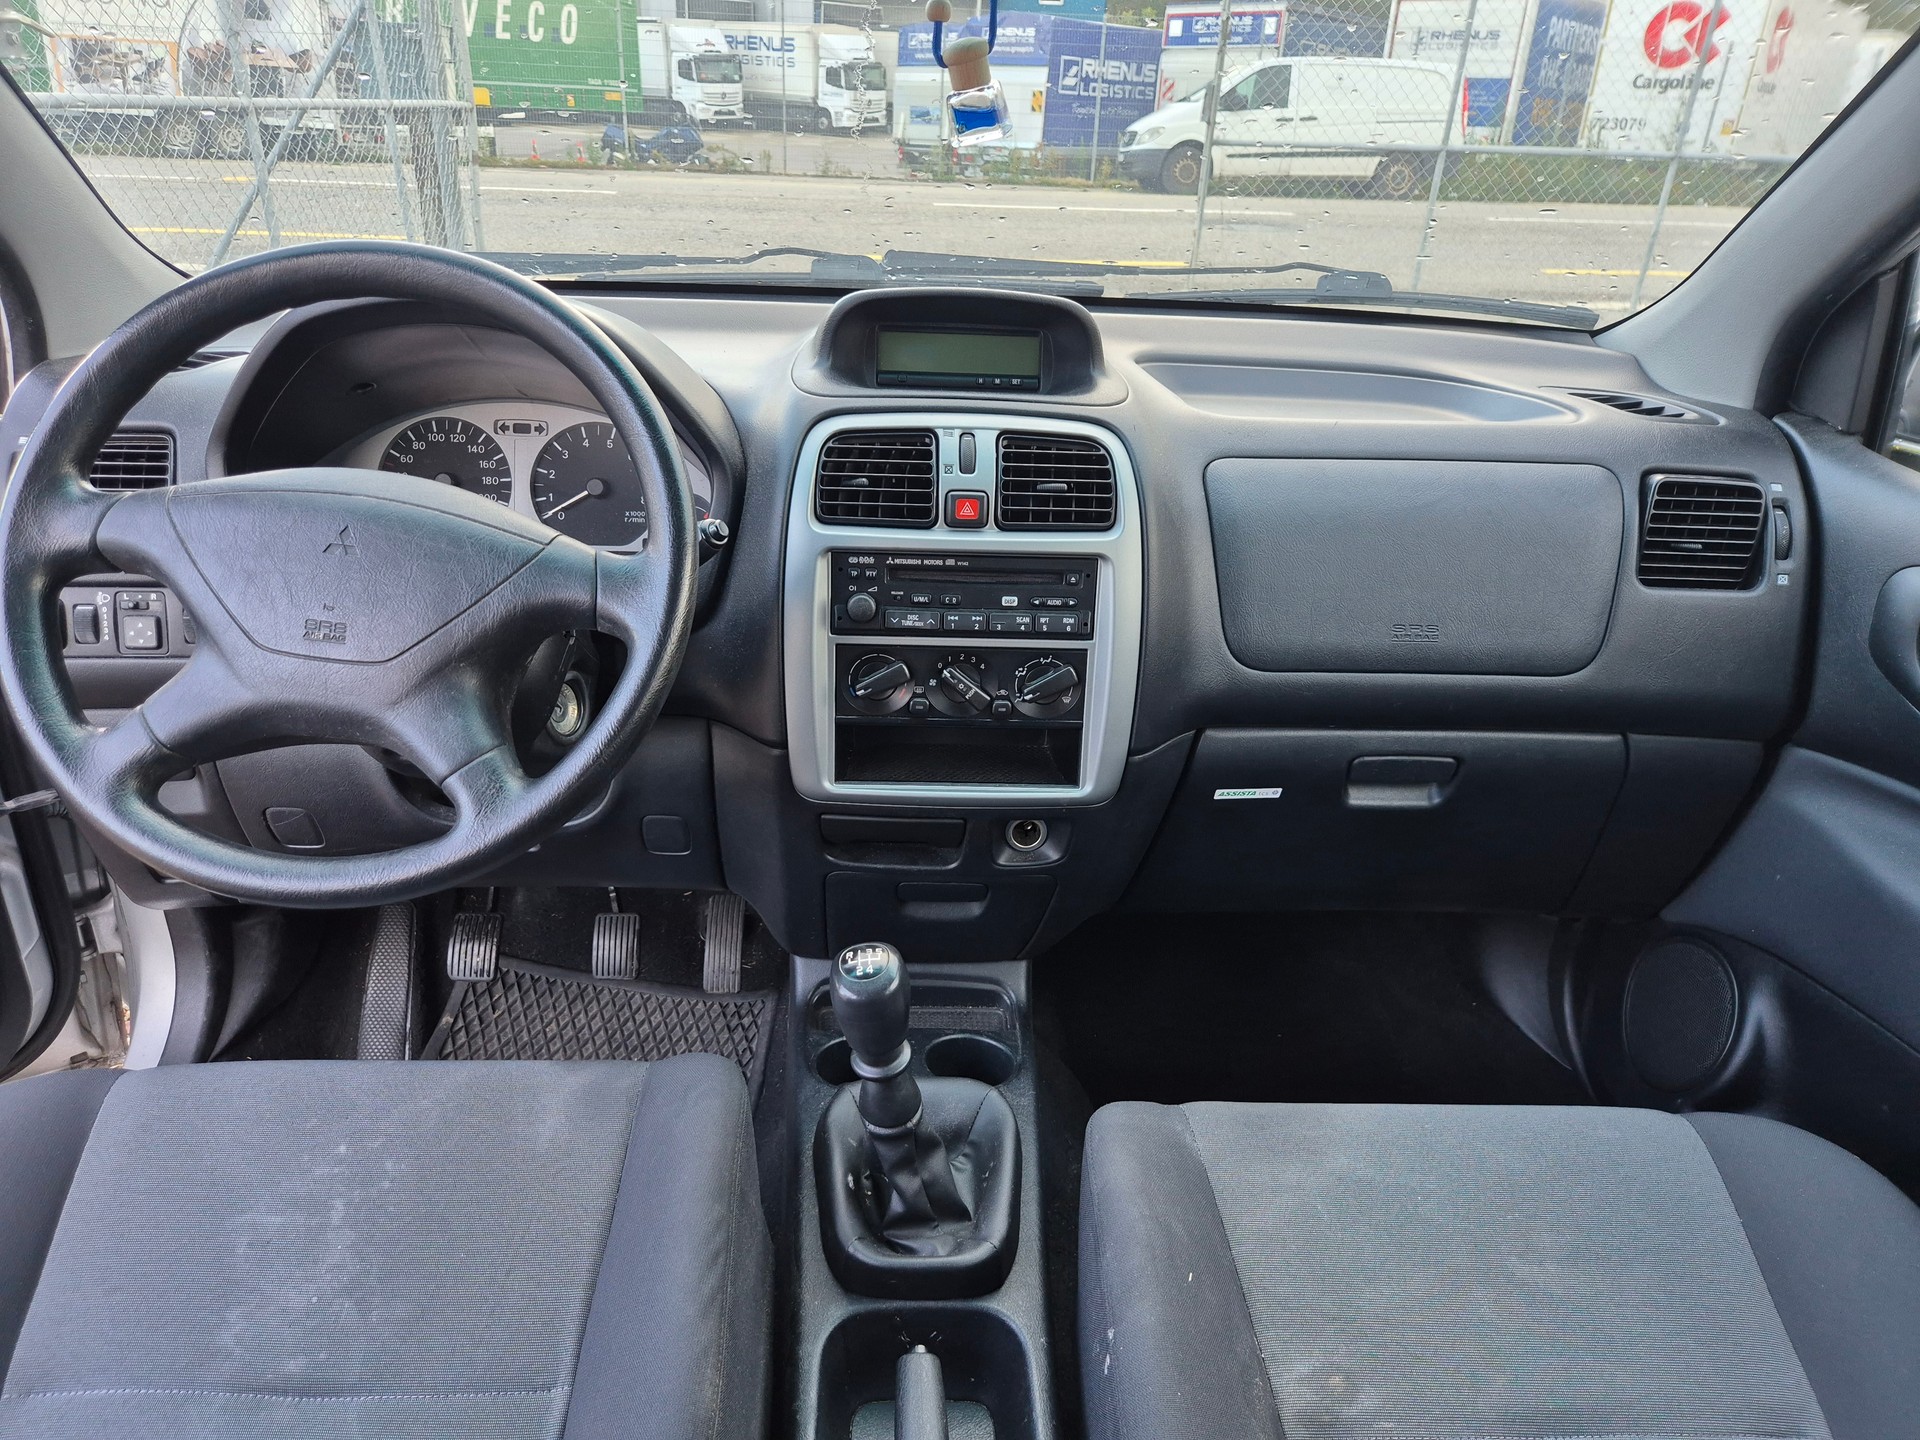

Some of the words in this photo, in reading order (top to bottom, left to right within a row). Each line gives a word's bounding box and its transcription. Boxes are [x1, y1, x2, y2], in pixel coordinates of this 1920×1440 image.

[724, 34, 796, 53] RHENUS
[734, 54, 796, 68] OGISTICS
[1081, 57, 1158, 83] RHENUS
[1080, 81, 1155, 100] LOGISTICS
[427, 433, 446, 443] 100
[449, 433, 466, 443] 120
[412, 440, 426, 450] 80
[582, 439, 590, 448] 4
[607, 439, 614, 448] 5
[467, 444, 485, 454] 140
[400, 454, 414, 463] 60
[562, 450, 569, 459] 3
[479, 459, 496, 469] 160
[549, 469, 556, 479] 2
[481, 476, 499, 485] 180
[557, 511, 565, 520] 0
[304, 618, 347, 633] SRS
[1391, 624, 1440, 634] SRS
[845, 951, 854, 960] R
[855, 965, 864, 976] 2
[865, 964, 874, 974] 4
